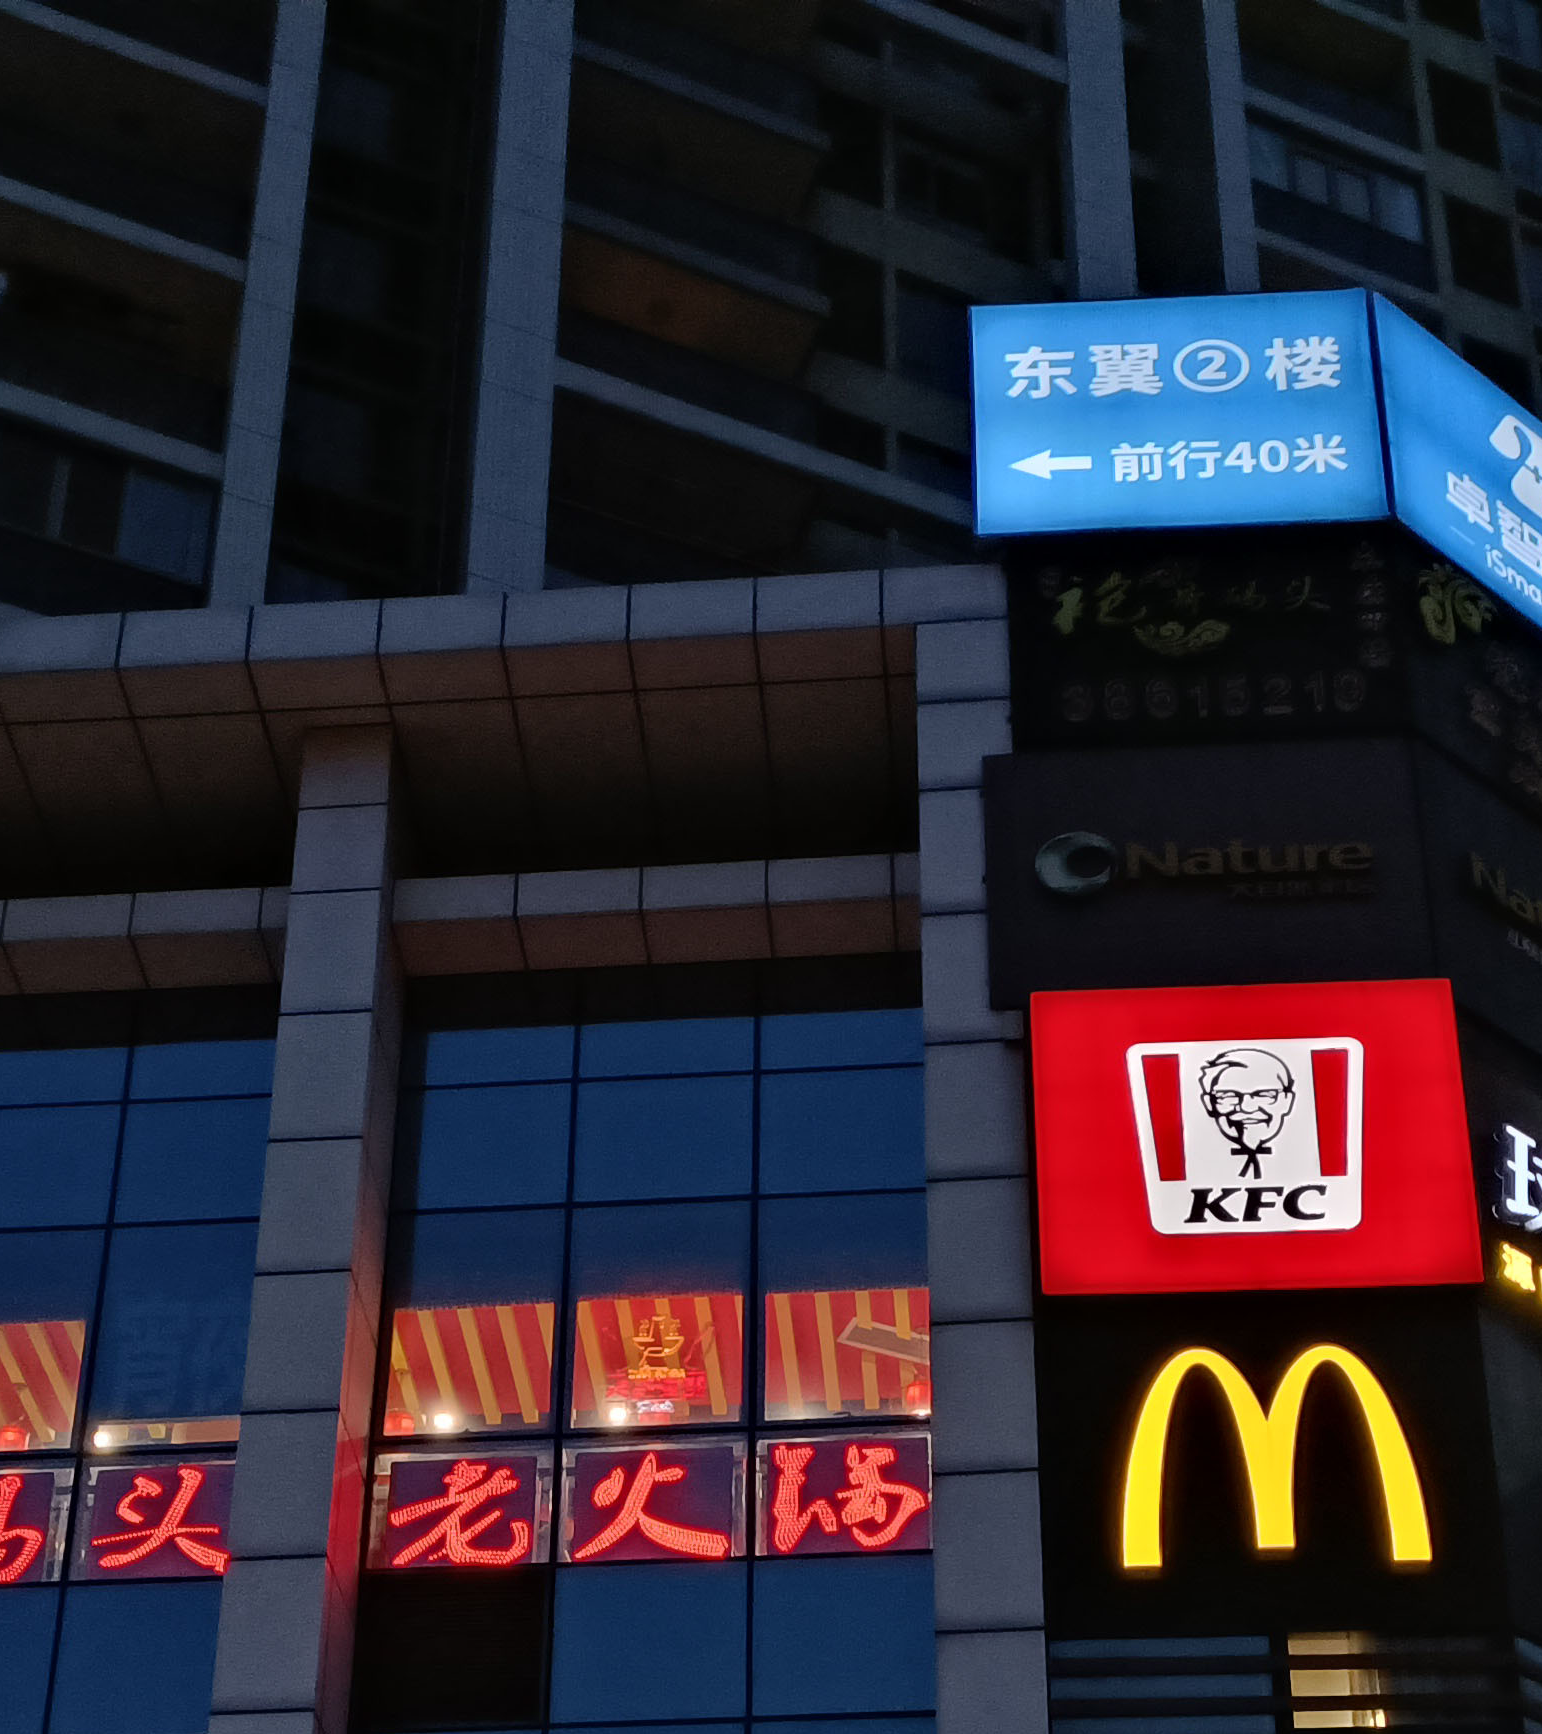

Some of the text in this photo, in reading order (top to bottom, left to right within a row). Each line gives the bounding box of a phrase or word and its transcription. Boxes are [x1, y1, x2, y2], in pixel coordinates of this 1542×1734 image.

[1005, 336, 1341, 399] 东翼②楼
[1110, 433, 1348, 483] 前行40米
[1124, 838, 1375, 880] Nature
[1182, 1183, 1328, 1225] KFC
[389, 1443, 928, 1567] 老火锅
